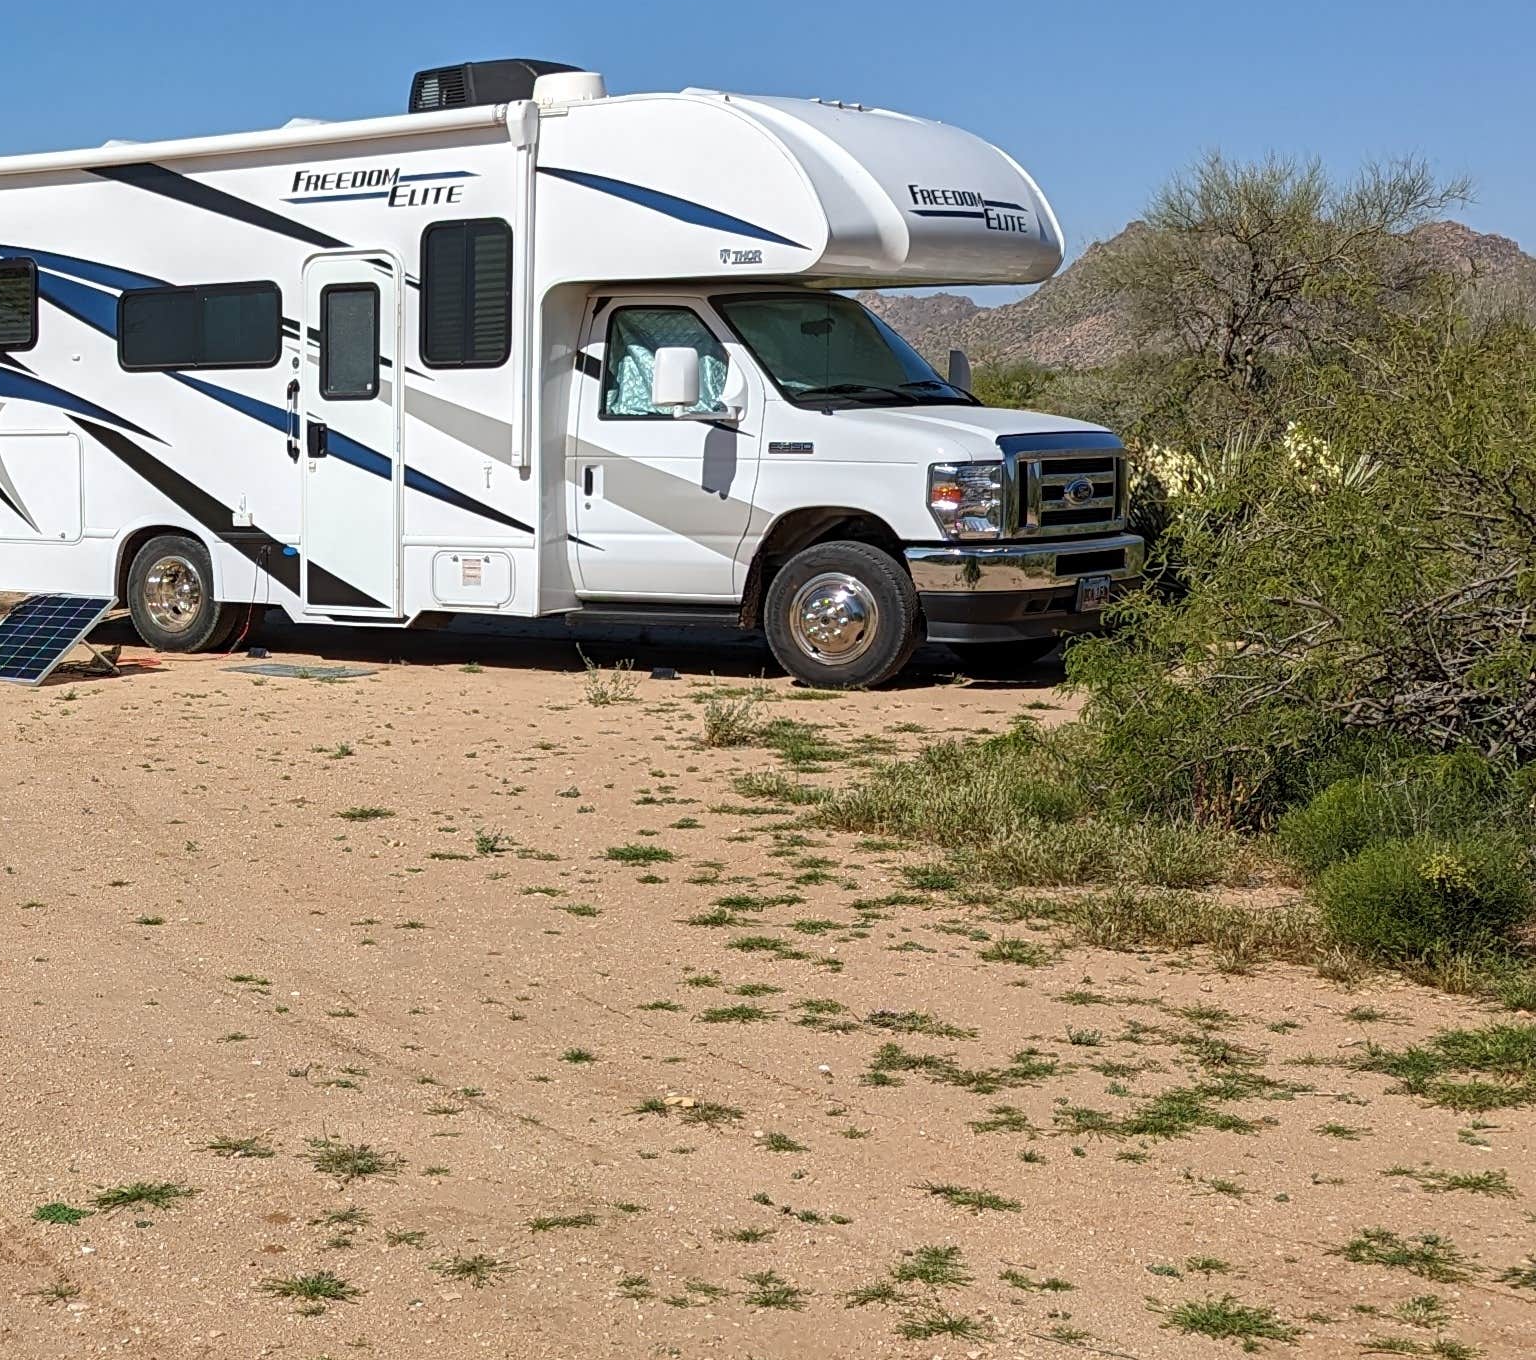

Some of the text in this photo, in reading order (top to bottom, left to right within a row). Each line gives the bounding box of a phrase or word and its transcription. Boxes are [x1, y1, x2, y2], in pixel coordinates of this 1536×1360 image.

[292, 168, 401, 192] FREEDOM
[388, 184, 465, 208] ELITE
[908, 184, 985, 208] FREEDOM
[983, 208, 1028, 233] ELITE
